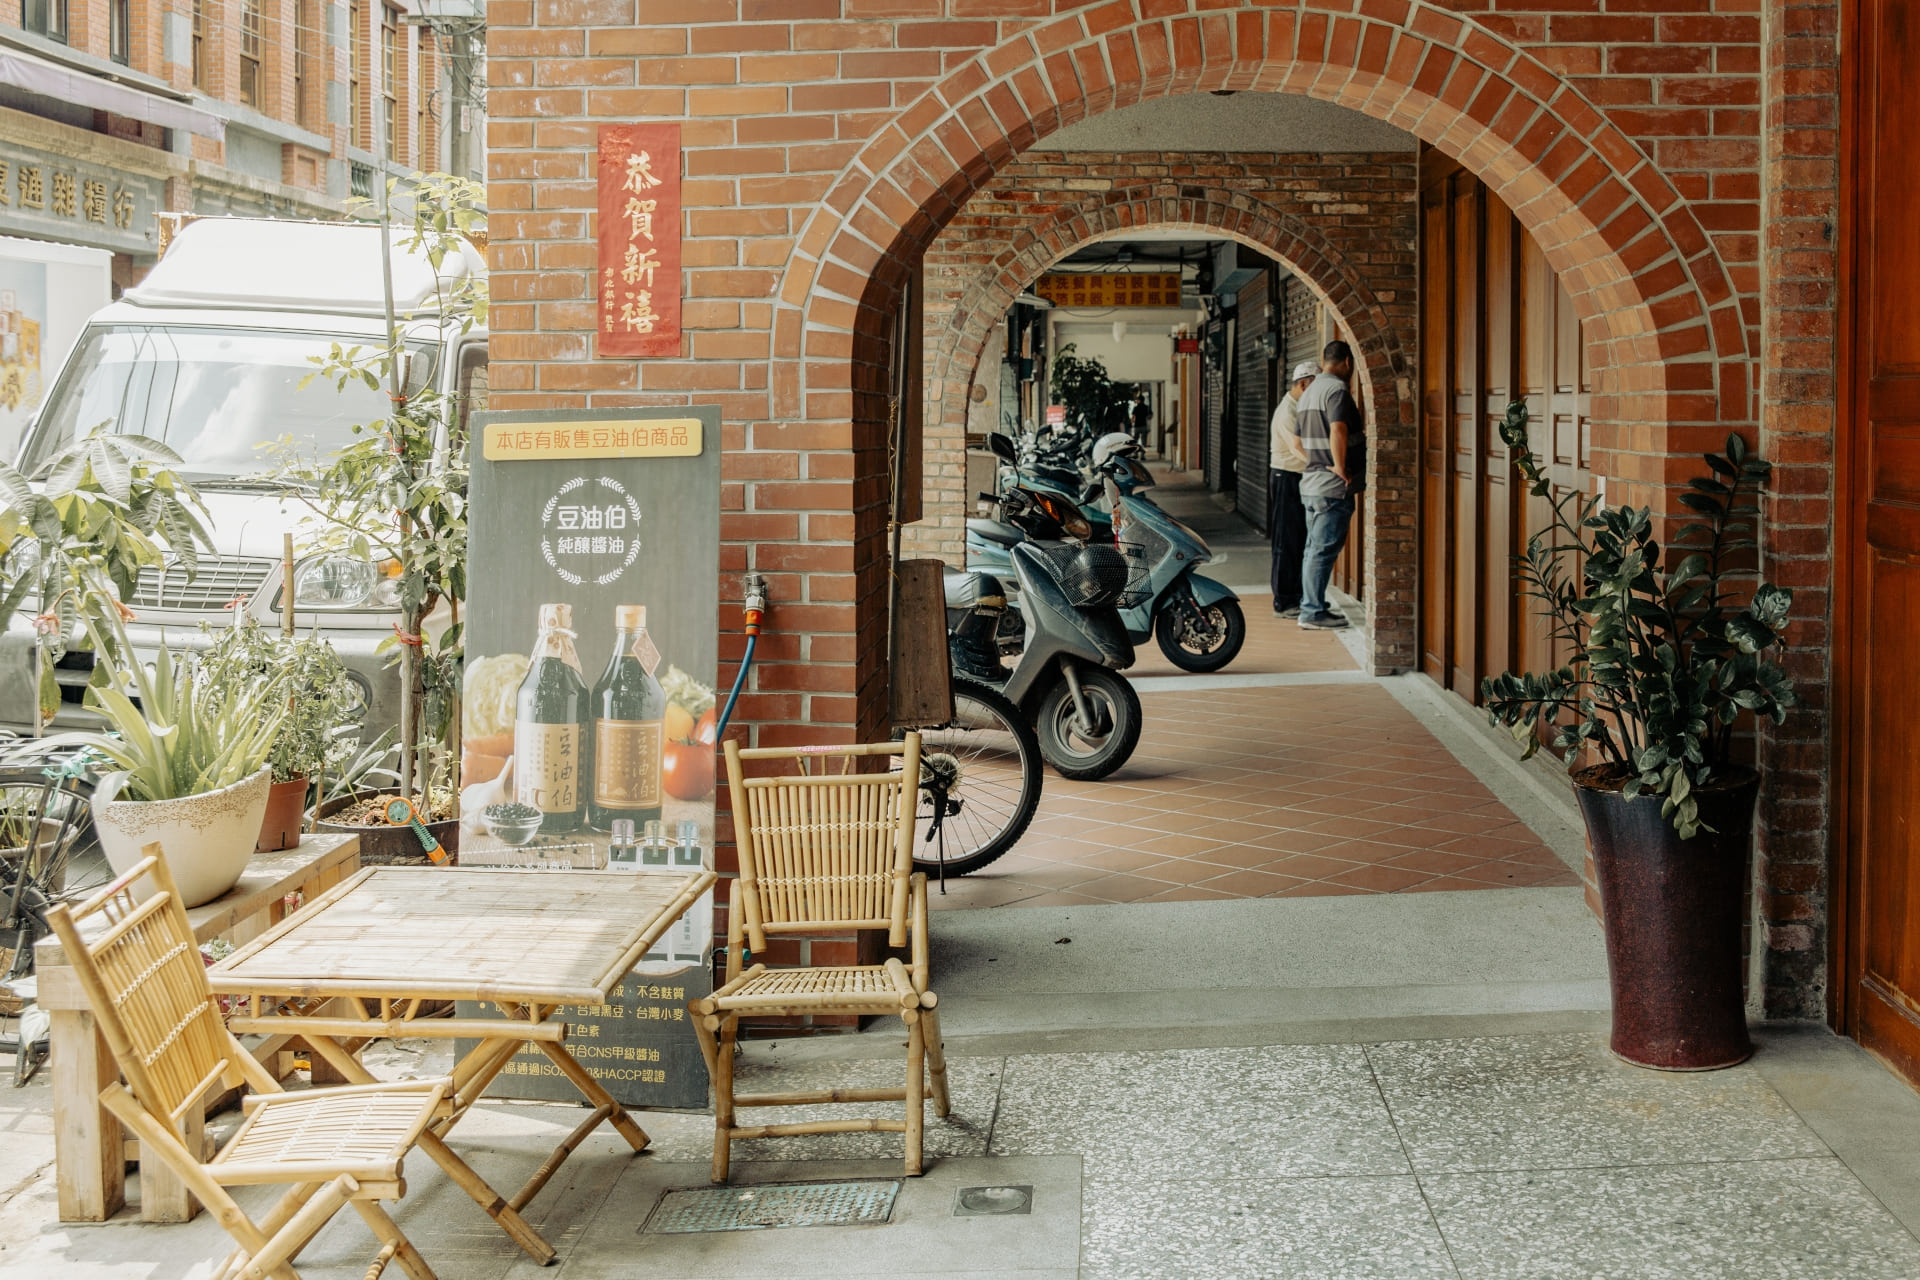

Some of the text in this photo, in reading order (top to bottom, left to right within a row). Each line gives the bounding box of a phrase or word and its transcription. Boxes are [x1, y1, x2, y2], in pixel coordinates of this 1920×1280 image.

[620, 150, 663, 335] 恭賀新禧
[496, 426, 688, 450] 本店有販售豆油伯商品
[557, 505, 626, 530] 豆油伯
[557, 536, 625, 554] 純釀醬油
